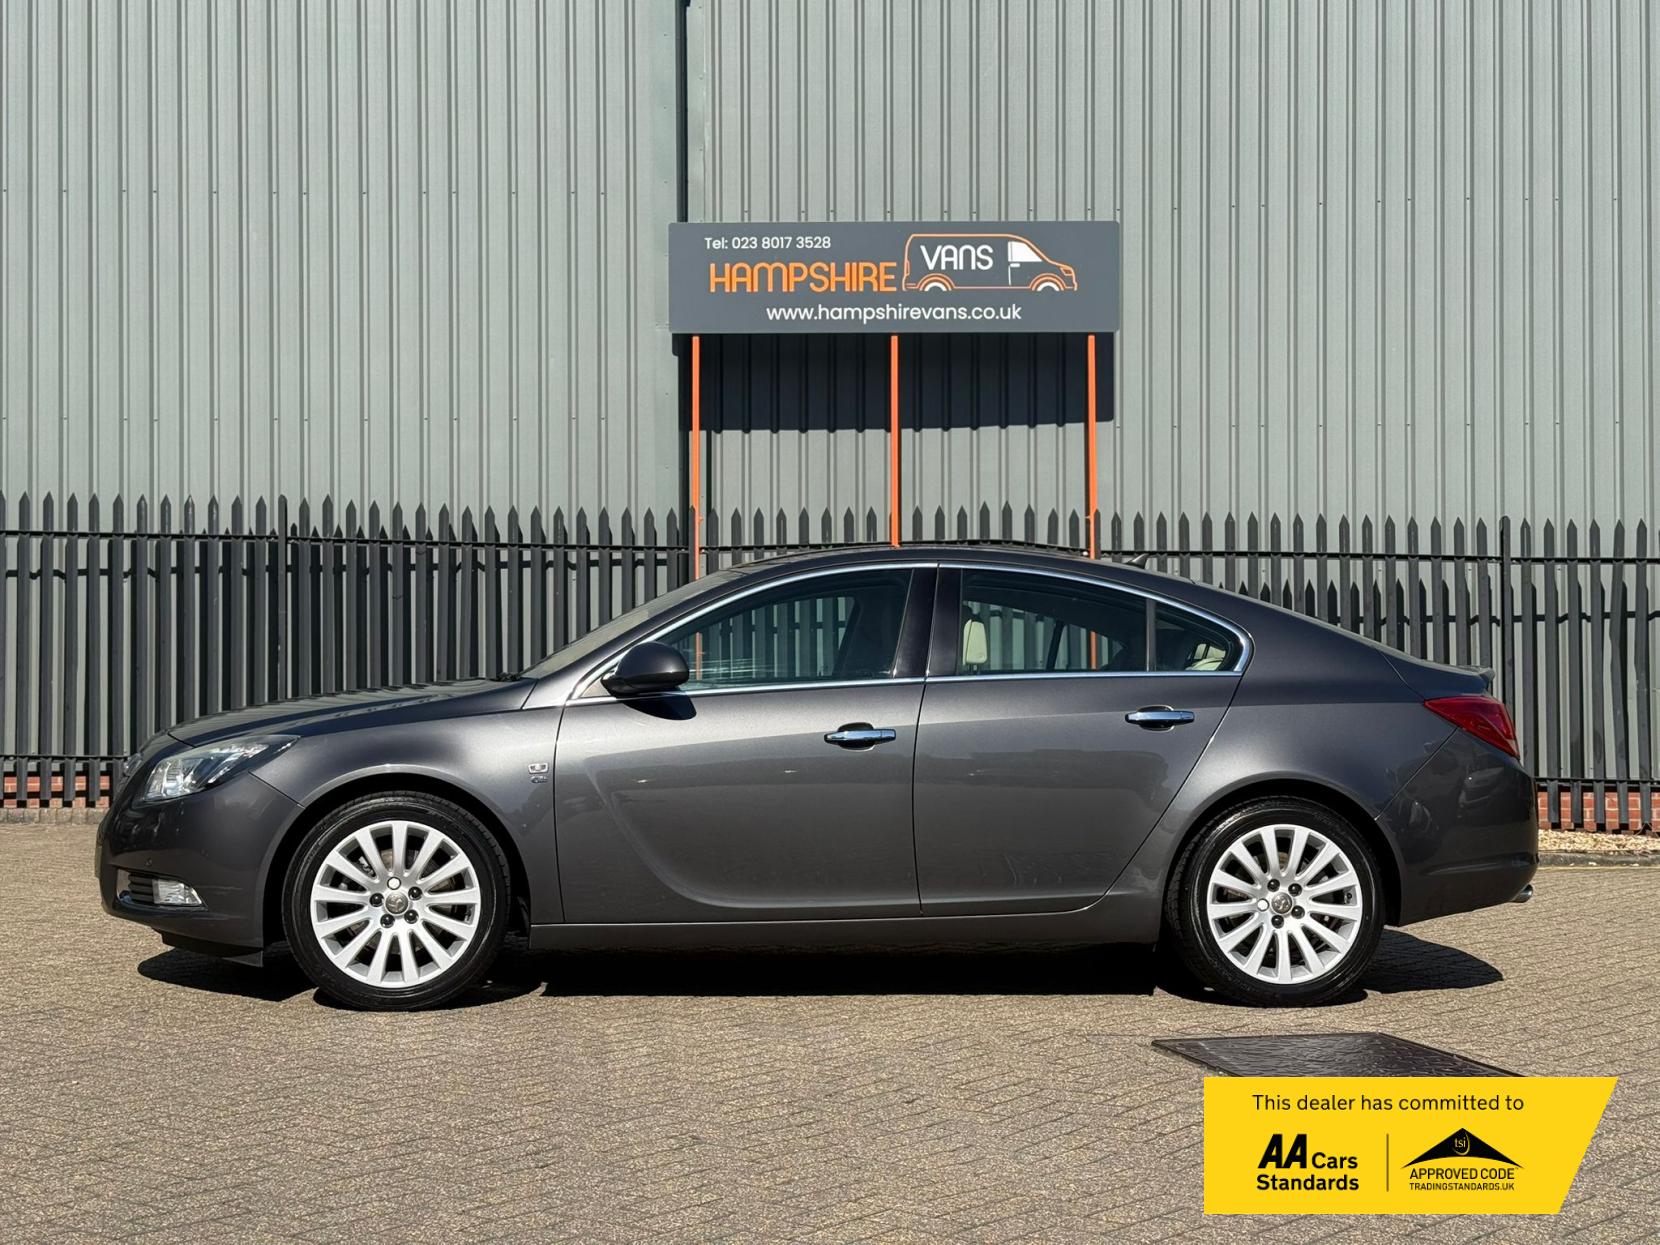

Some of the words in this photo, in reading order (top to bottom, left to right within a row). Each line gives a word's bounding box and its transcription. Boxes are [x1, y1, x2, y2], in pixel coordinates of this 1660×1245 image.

[704, 236, 729, 250] Tel:
[731, 236, 758, 250] 023
[761, 236, 793, 250] 8017
[795, 235, 832, 249] 3528
[709, 262, 897, 293] HAMPSHIRE
[919, 244, 994, 271] VANS
[765, 303, 1023, 325] www.hampshirevans.co.uk
